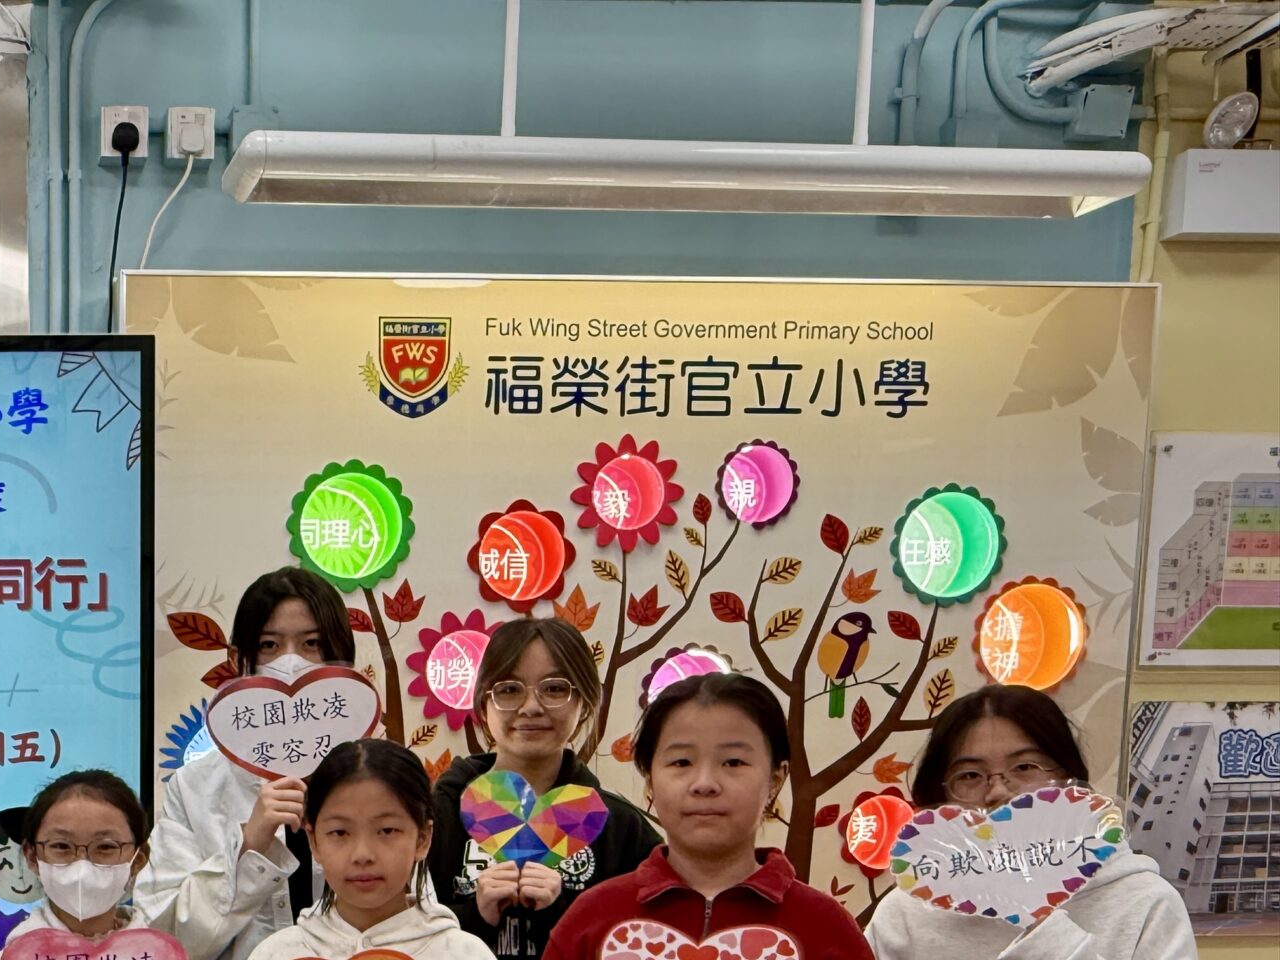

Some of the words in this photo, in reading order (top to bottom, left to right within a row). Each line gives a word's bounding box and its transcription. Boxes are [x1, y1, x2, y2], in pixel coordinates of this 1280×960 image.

[485, 317, 522, 337] Fuk
[529, 317, 580, 342] Wing
[587, 318, 648, 338] Street
[653, 319, 777, 340] Government
[784, 320, 860, 345] Primary
[866, 321, 934, 341] School
[391, 342, 438, 364] FWS
[485, 355, 930, 419] 福榮街官立小學
[232, 691, 350, 731] 校園欺凌
